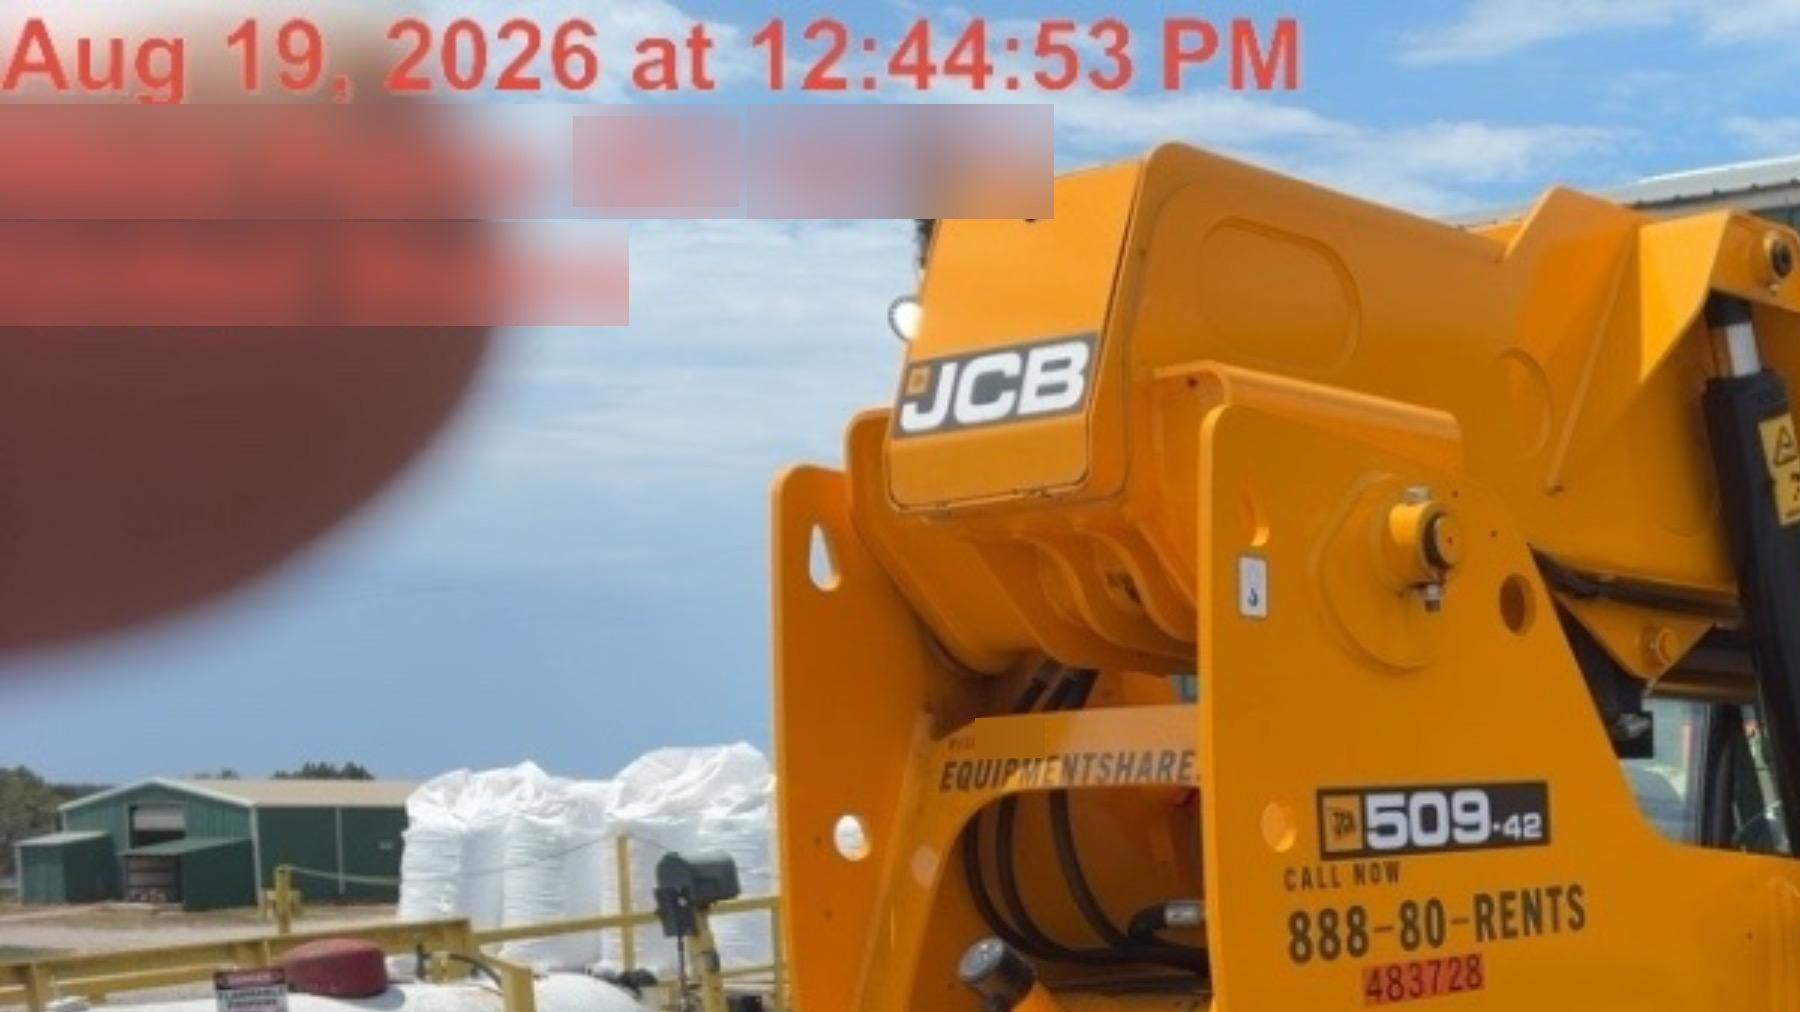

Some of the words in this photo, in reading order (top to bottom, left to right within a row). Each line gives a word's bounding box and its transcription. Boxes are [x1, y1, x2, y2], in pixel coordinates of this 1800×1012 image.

[900, 341, 1090, 432] JCB
[1284, 865, 1342, 891] CALL
[1353, 861, 1400, 885] NOW
[1288, 884, 1586, 965] 888-80-RENTS
[1365, 953, 1483, 1002] 483728
